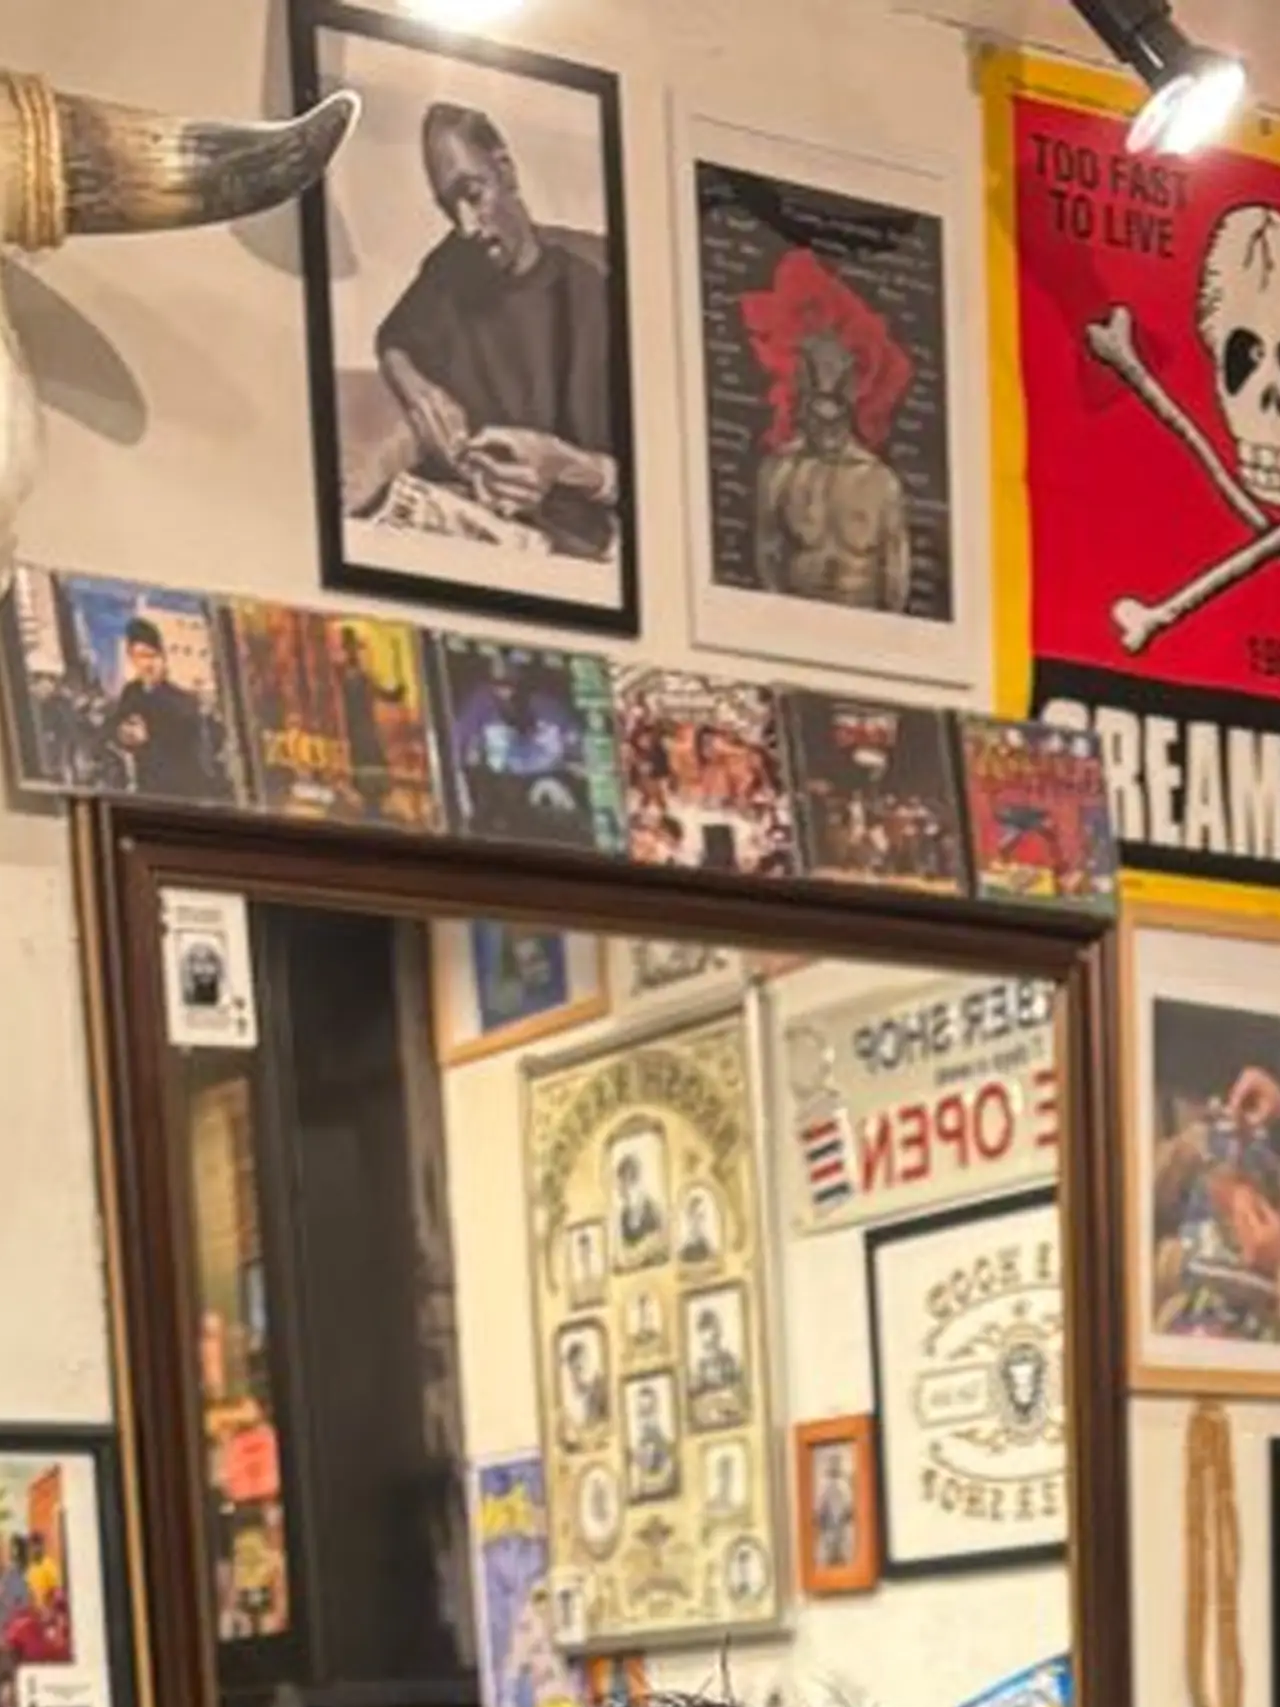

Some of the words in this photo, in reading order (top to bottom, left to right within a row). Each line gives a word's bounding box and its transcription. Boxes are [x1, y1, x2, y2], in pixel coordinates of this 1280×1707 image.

[1031, 134, 1099, 191] TOO
[1109, 158, 1189, 209] FAST
[1049, 186, 1091, 240] TO
[1105, 203, 1175, 260] LIVE
